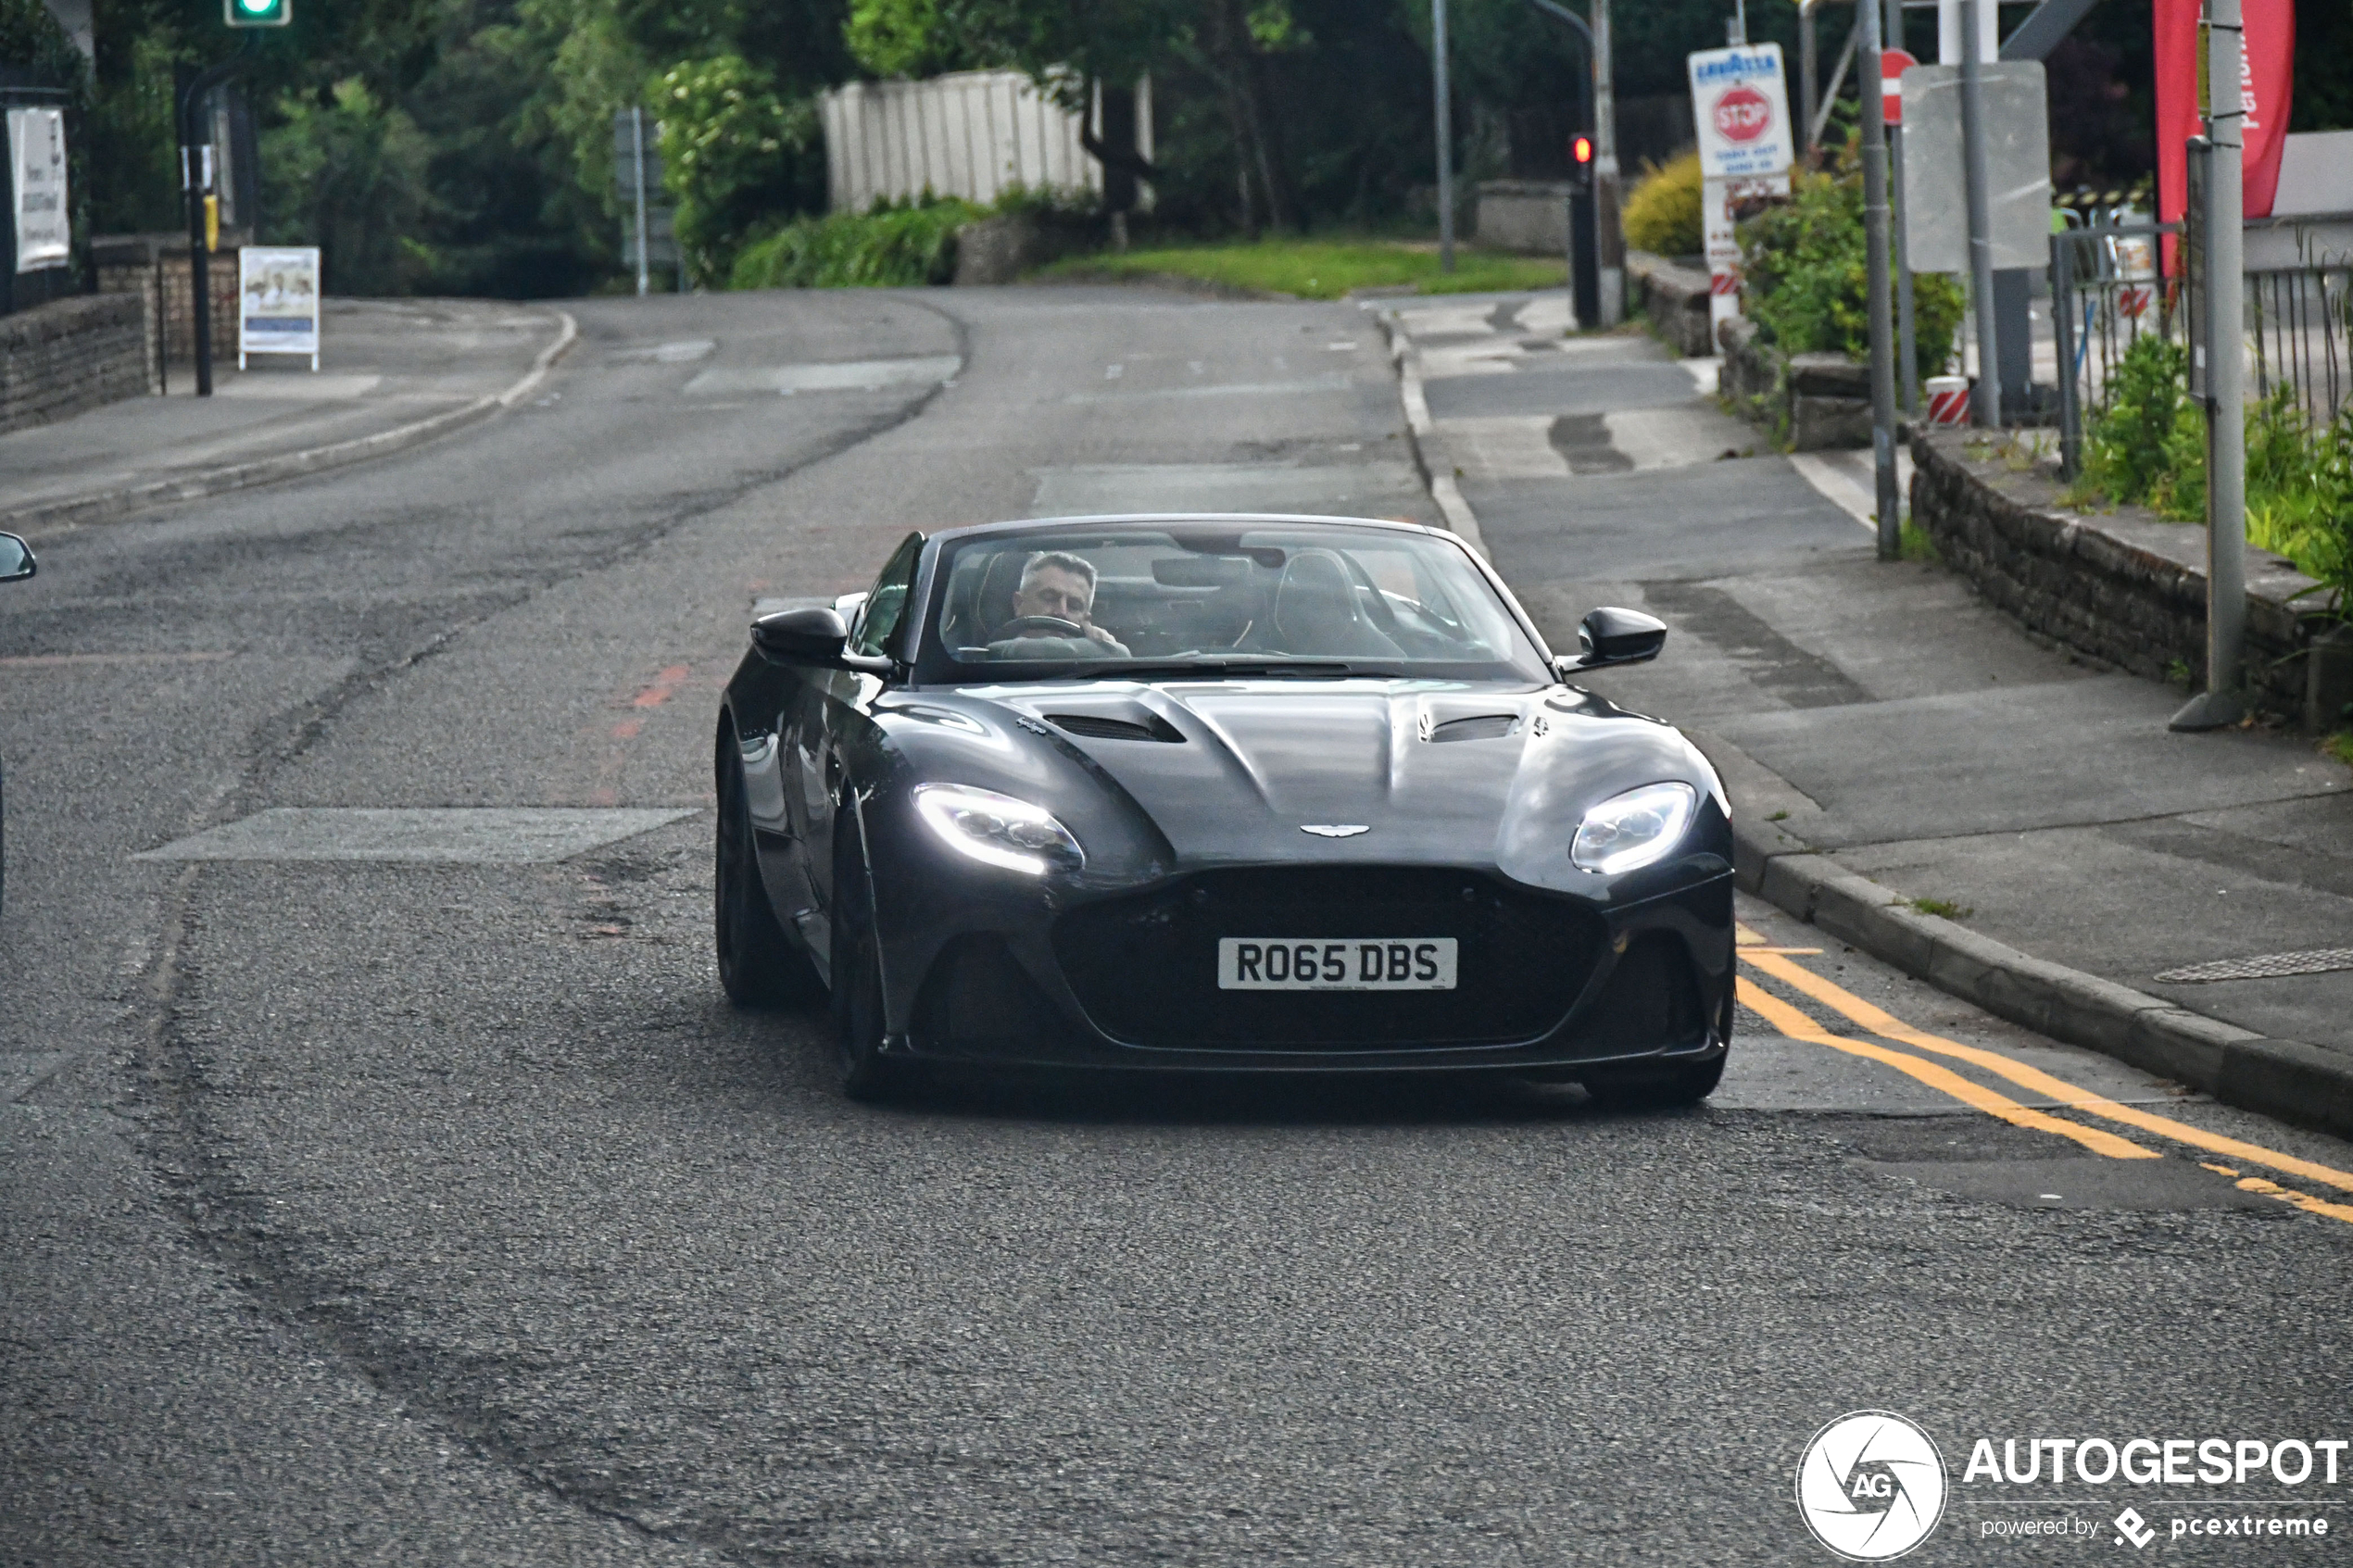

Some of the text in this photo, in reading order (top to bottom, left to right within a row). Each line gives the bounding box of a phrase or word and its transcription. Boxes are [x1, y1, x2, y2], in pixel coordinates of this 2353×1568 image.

[1718, 103, 1768, 129] STOP
[1238, 944, 1439, 982] RO65 DBS
